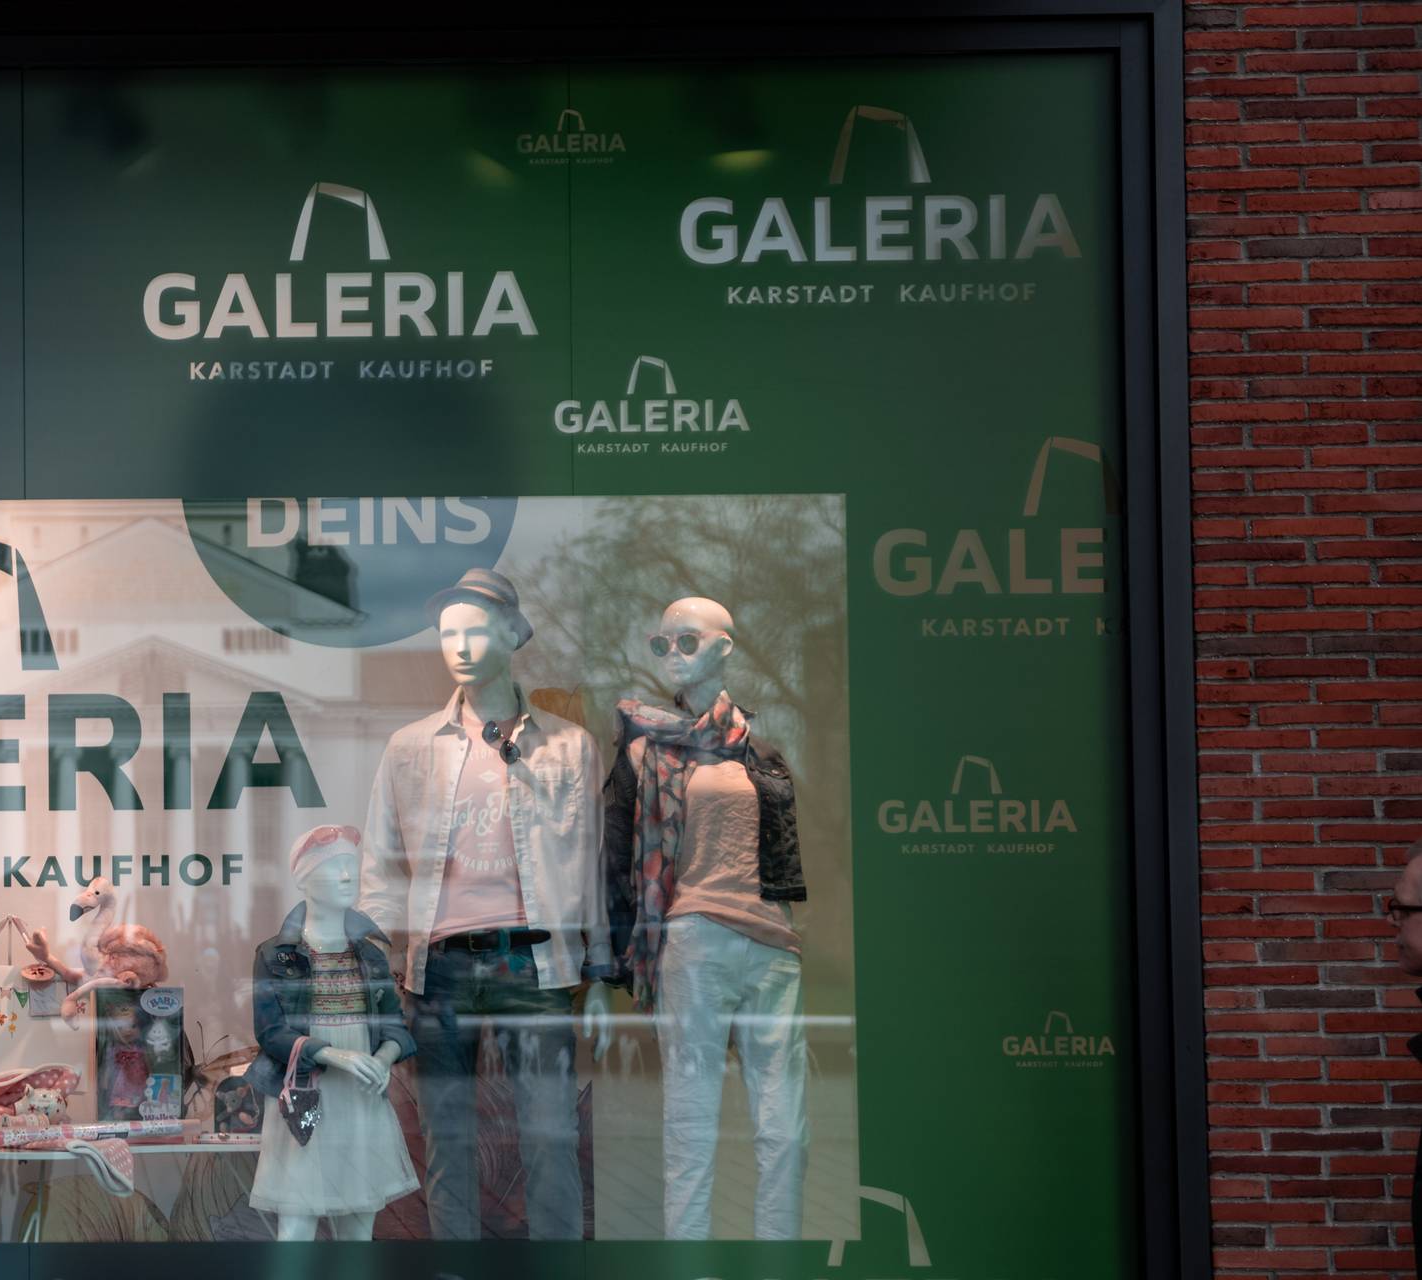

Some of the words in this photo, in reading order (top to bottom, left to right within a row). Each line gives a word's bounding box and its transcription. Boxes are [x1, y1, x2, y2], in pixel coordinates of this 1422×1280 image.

[517, 133, 626, 153] GALERIA
[680, 193, 1082, 265] GALERIA
[143, 271, 539, 340] GALERIA
[727, 285, 875, 305] KARSTADT
[900, 283, 1037, 303] KAUFHOF
[190, 361, 335, 380] KARSTADT
[359, 359, 494, 379] KAUFHOF
[554, 398, 750, 434] GALERIA
[578, 443, 650, 454] KARSTADT
[661, 442, 728, 453] KAUFHOF
[246, 497, 491, 548] DEINS
[873, 527, 1107, 597] GALE
[922, 618, 1070, 637] KARSTADT
[878, 799, 1078, 834] GALERIA
[901, 844, 975, 855] KARSTADT
[986, 843, 1056, 854] KAUFHOF
[2, 853, 244, 888] KAUFHOF
[1002, 1036, 1115, 1057] GALERIA
